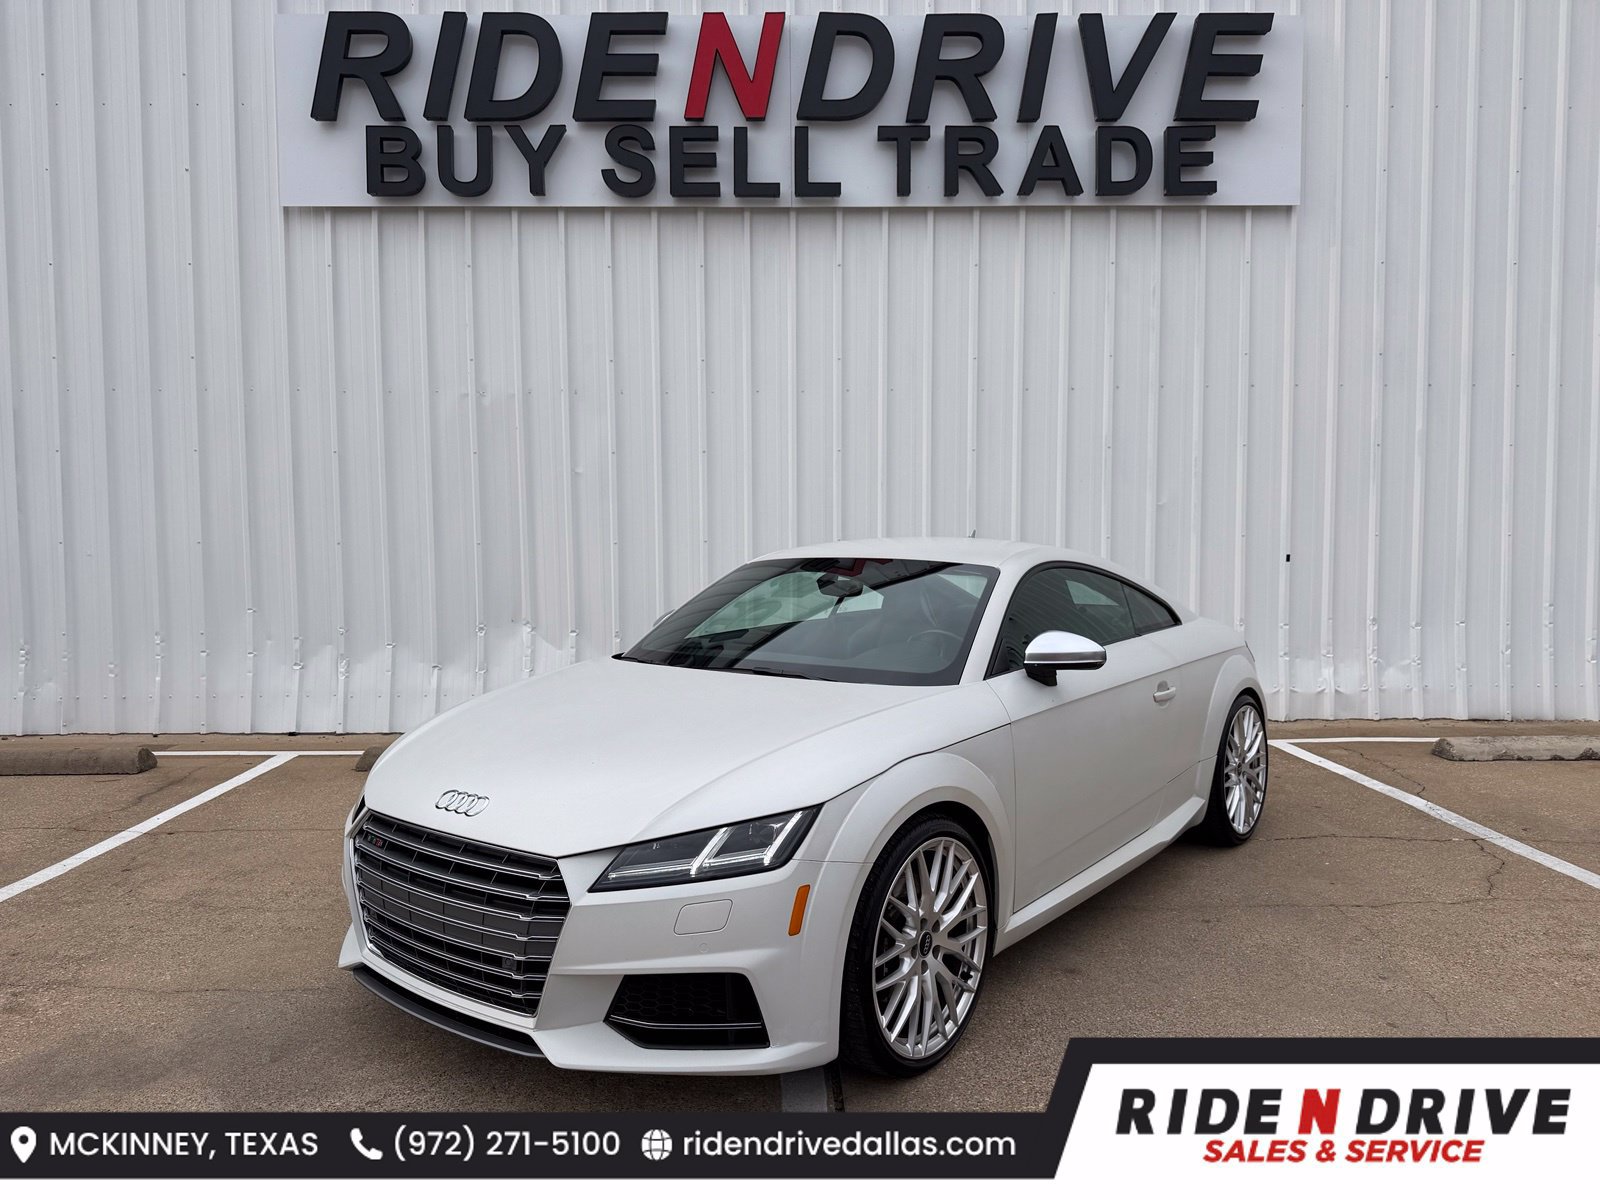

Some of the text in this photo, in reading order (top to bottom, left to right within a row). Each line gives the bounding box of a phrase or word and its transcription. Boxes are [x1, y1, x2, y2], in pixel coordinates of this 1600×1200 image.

[310, 11, 1275, 123] RIDE N DRIVE
[365, 124, 1217, 198] BUY SELL TRADE
